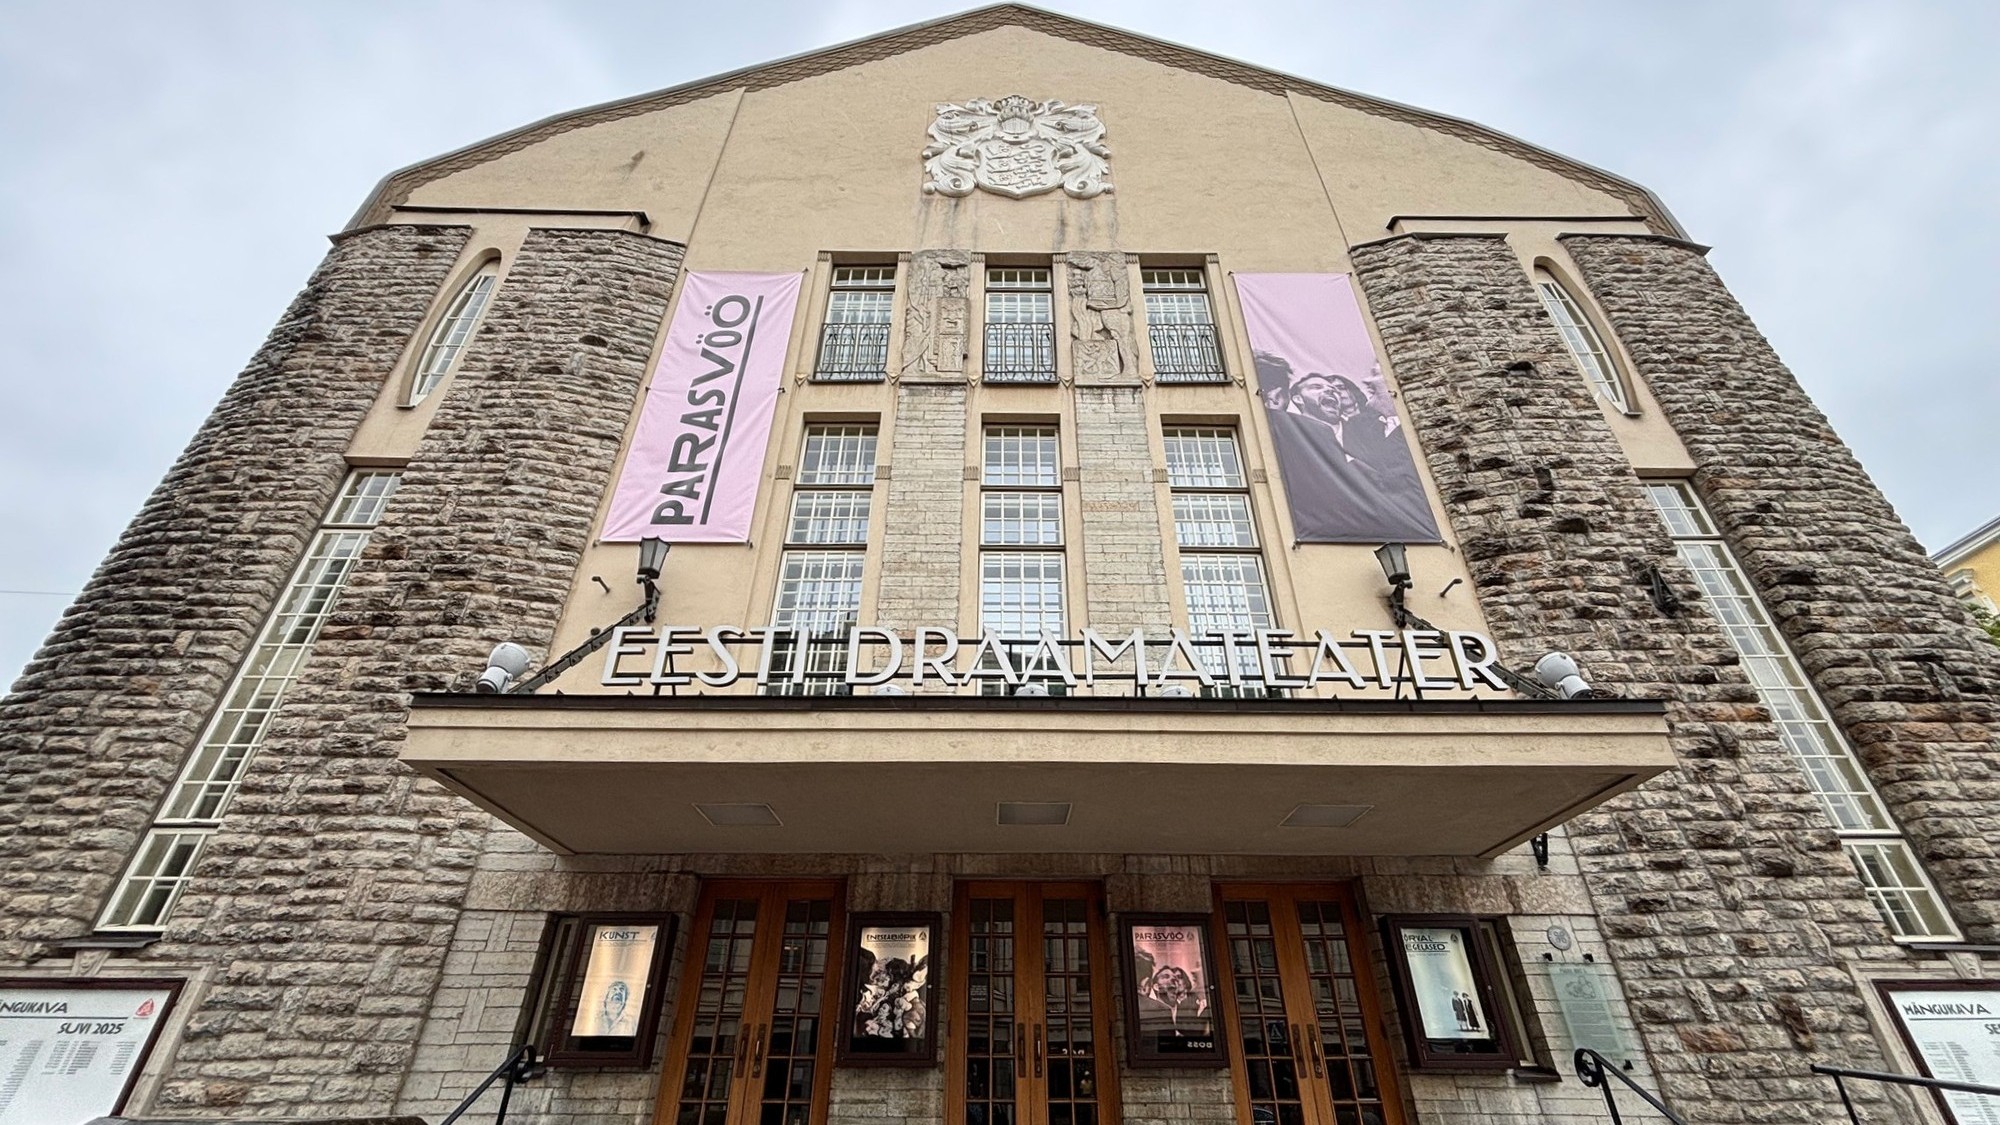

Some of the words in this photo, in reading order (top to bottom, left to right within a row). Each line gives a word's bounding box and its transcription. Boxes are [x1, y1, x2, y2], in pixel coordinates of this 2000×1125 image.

[651, 295, 750, 525] PARASVÖÖ
[601, 625, 810, 687] EESTI
[845, 626, 1509, 690] DRAAMATEATER
[599, 931, 640, 940] KUNST
[1902, 1002, 1992, 1015] MÄNGUKAVA
[57, 1022, 92, 1034] SUVI
[91, 1022, 125, 1035] 2025
